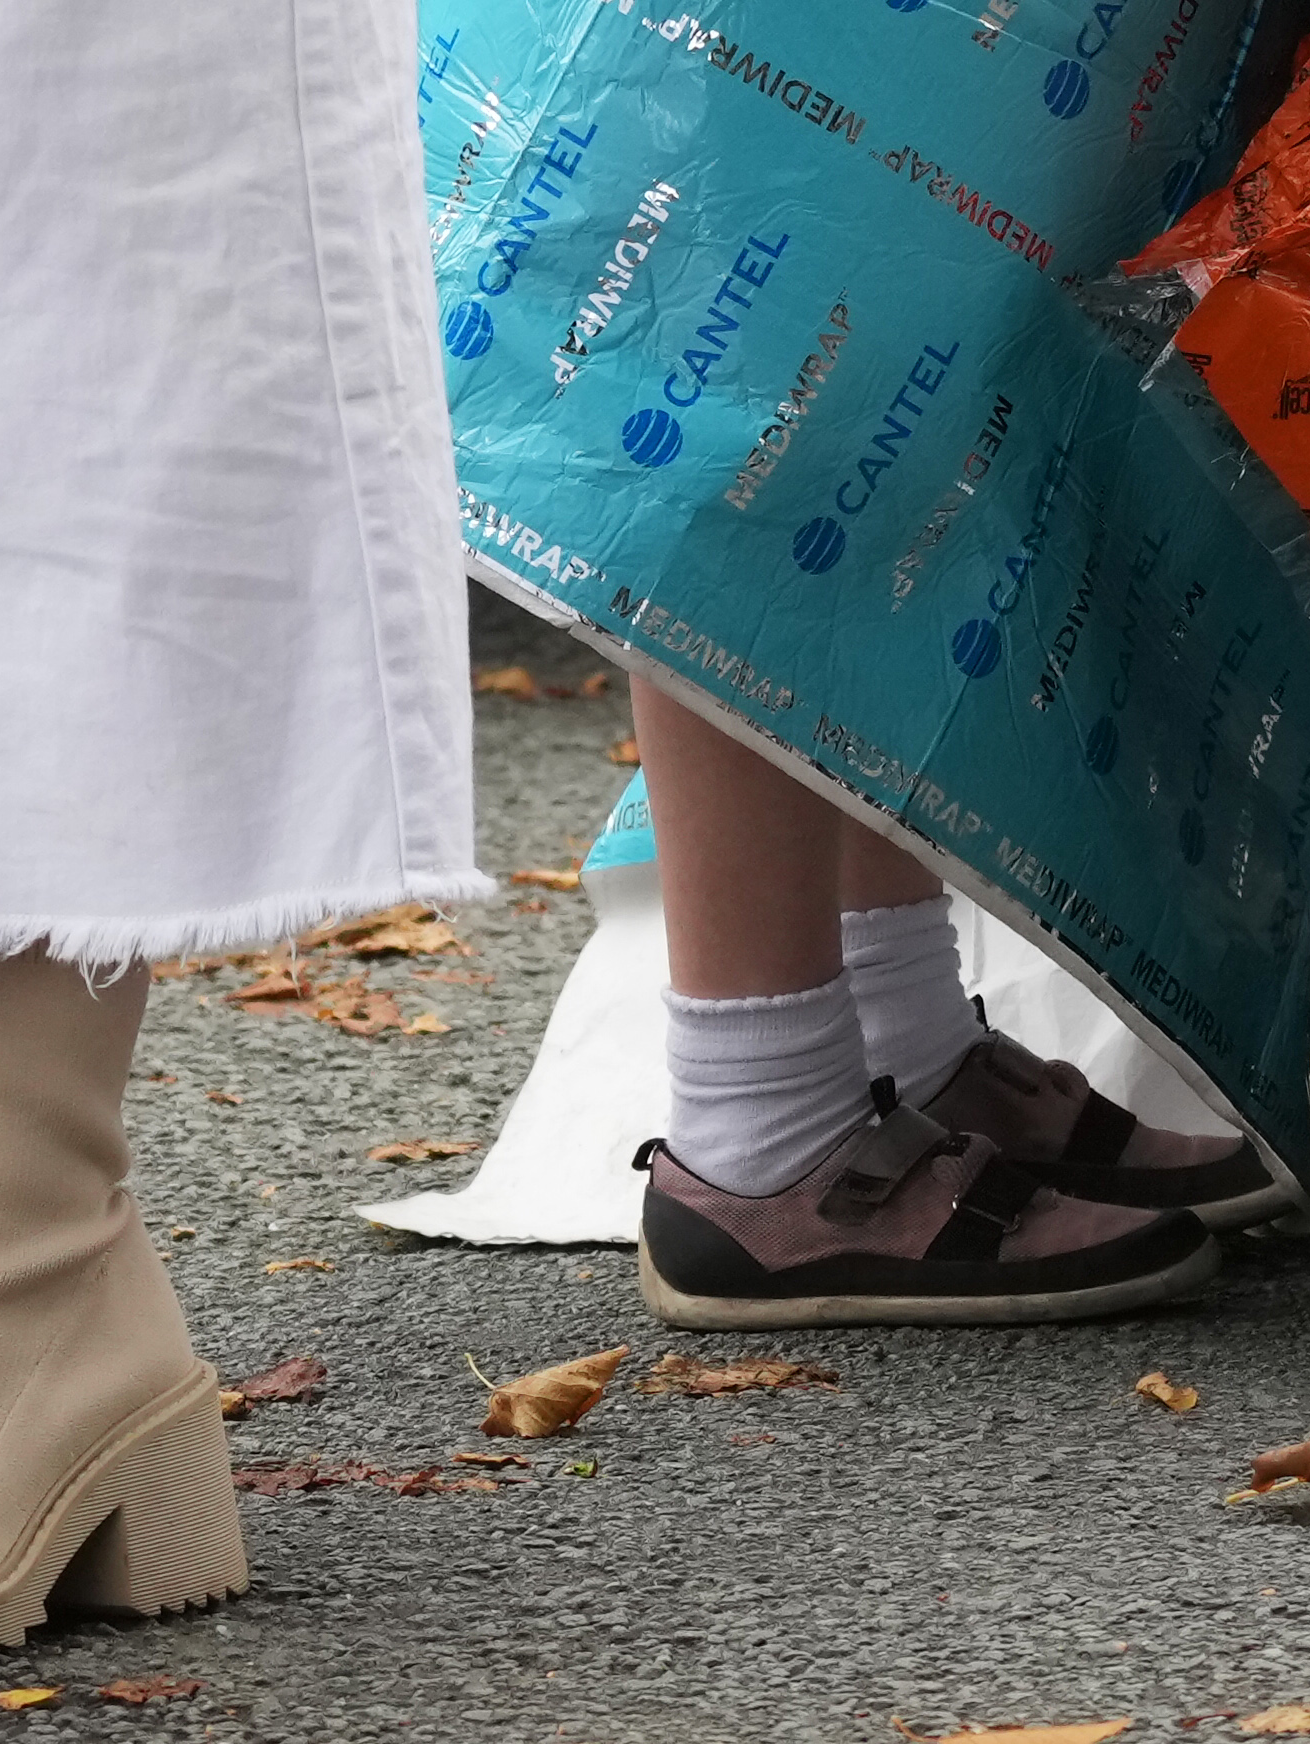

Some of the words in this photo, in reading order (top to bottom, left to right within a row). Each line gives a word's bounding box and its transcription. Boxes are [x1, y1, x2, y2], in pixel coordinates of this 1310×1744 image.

[477, 123, 598, 297] CANTEL
[663, 232, 790, 408] CANTEL
[835, 340, 961, 517] CANTEL
